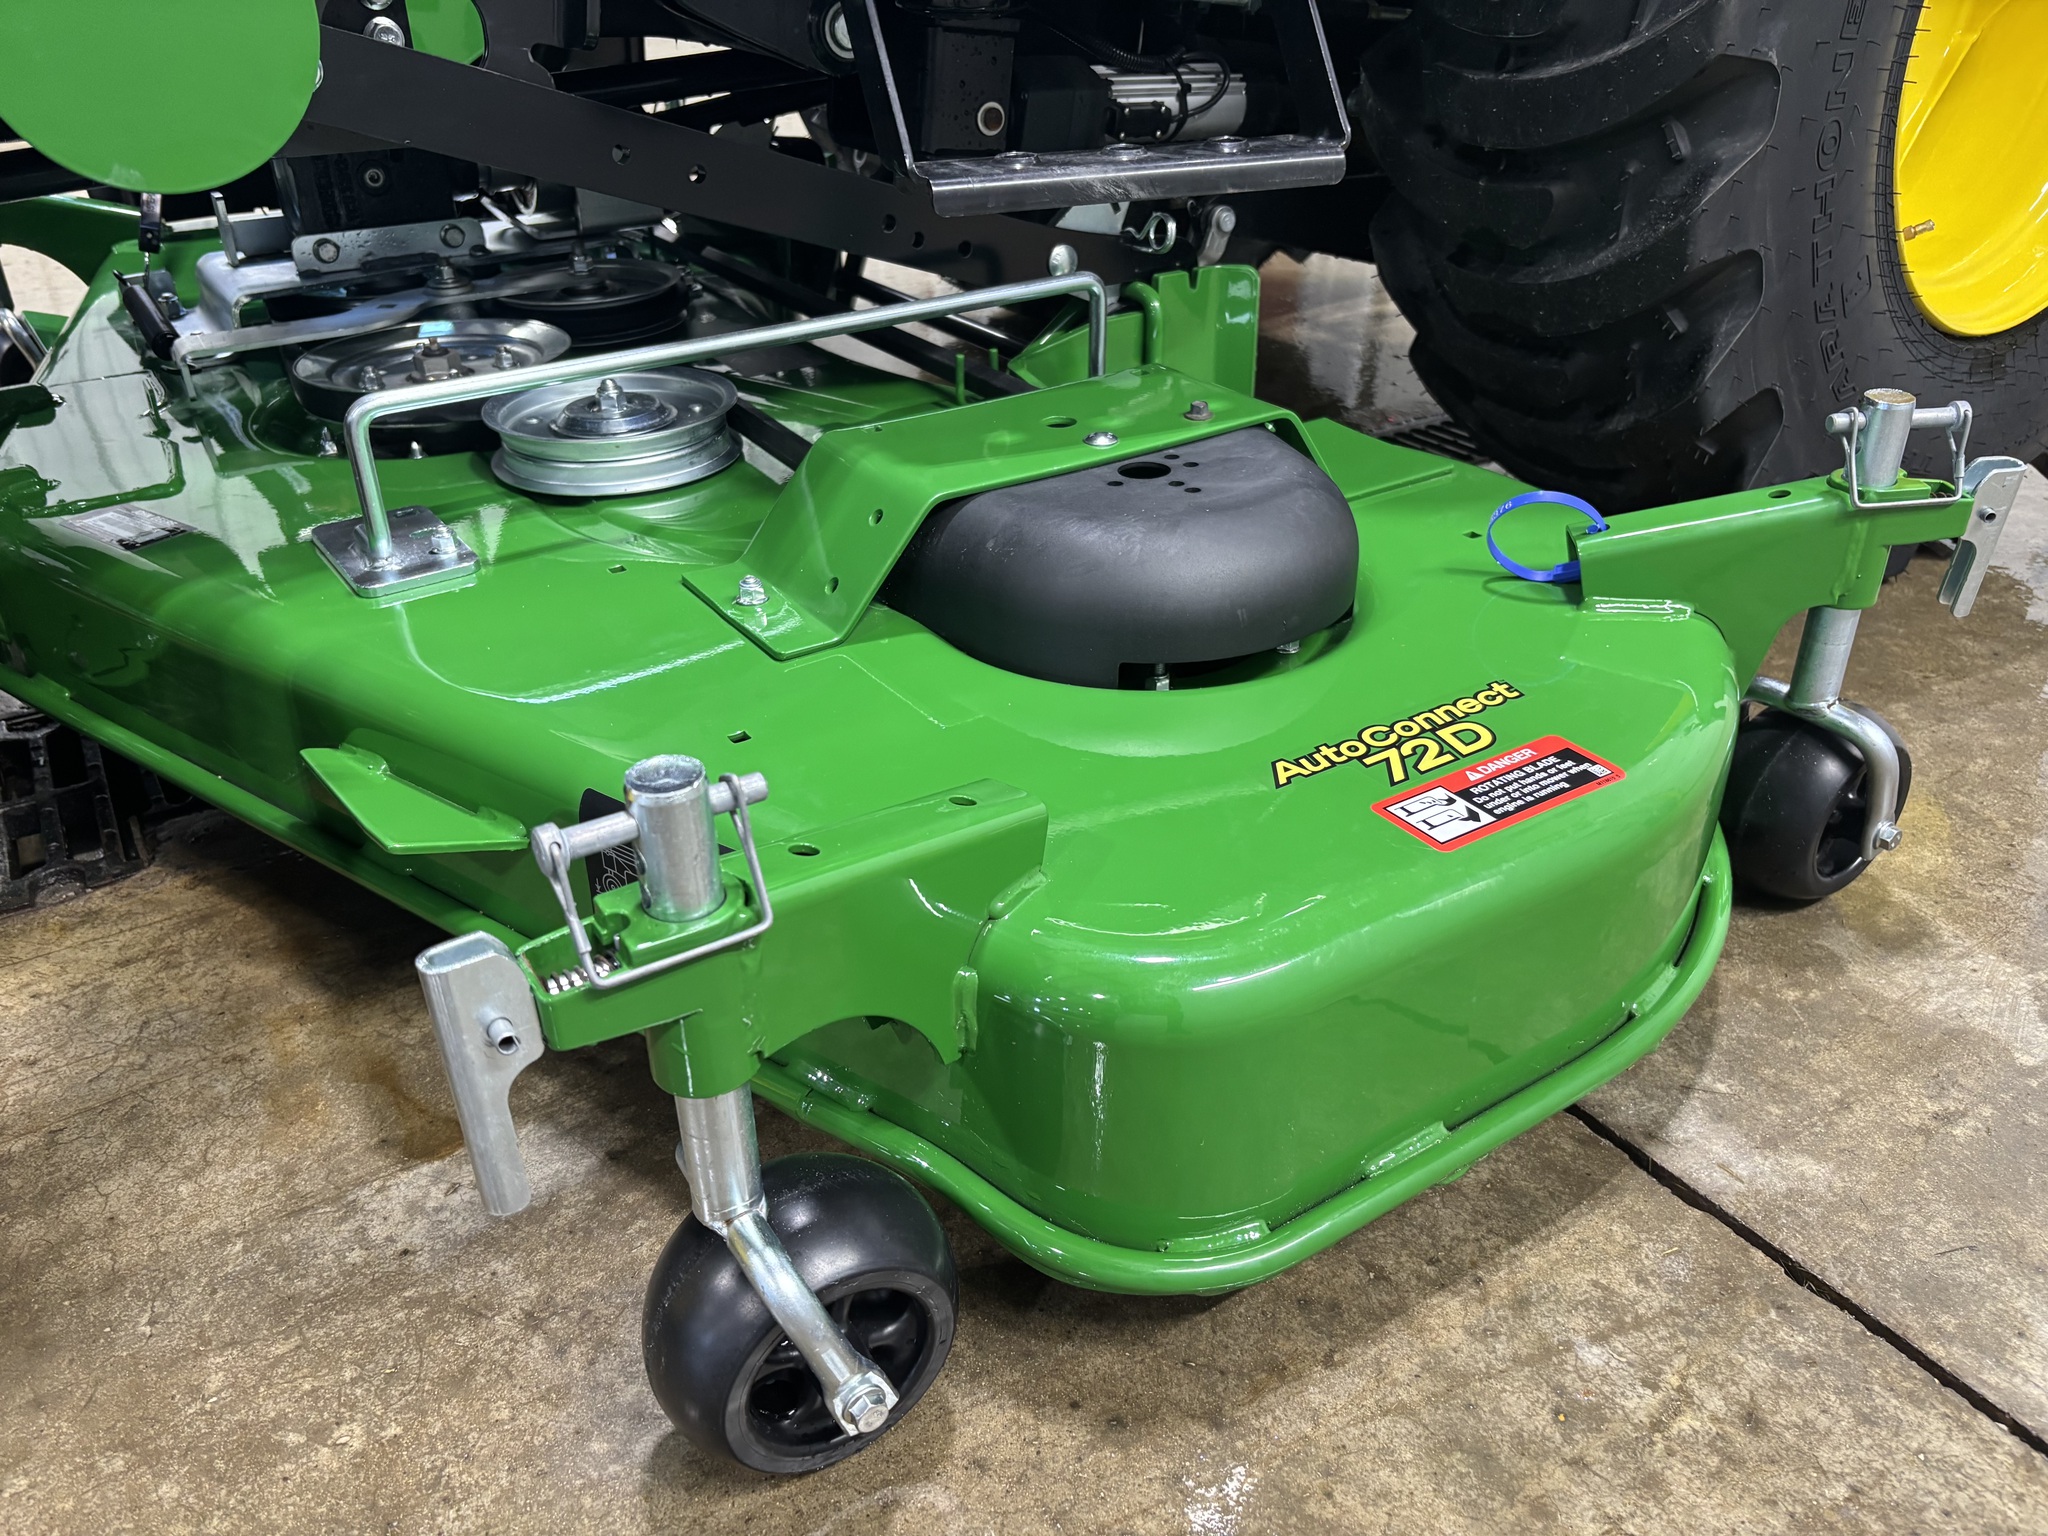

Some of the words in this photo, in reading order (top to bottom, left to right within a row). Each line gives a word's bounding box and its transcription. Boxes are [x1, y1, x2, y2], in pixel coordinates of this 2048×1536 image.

[1812, 0, 1868, 402] ARATHONE
[1271, 679, 1524, 789] AutoConnect
[1361, 720, 1497, 787] 72D
[1469, 769, 1526, 795] ROTATING
[1522, 755, 1561, 773] BLADE
[1472, 795, 1490, 804] Do
[1488, 788, 1506, 798] not
[1503, 781, 1522, 793] put
[1517, 771, 1549, 786] hands
[1546, 767, 1558, 775] or
[1555, 759, 1577, 770] feet
[1476, 748, 1537, 775] DANGER
[1483, 795, 1511, 809] under
[1510, 790, 1522, 798] or
[1518, 783, 1541, 794] into
[1538, 771, 1569, 787] mower
[1566, 762, 1593, 774] when
[1492, 799, 1526, 815] engine
[1521, 795, 1535, 803] is
[1532, 781, 1571, 798] running
